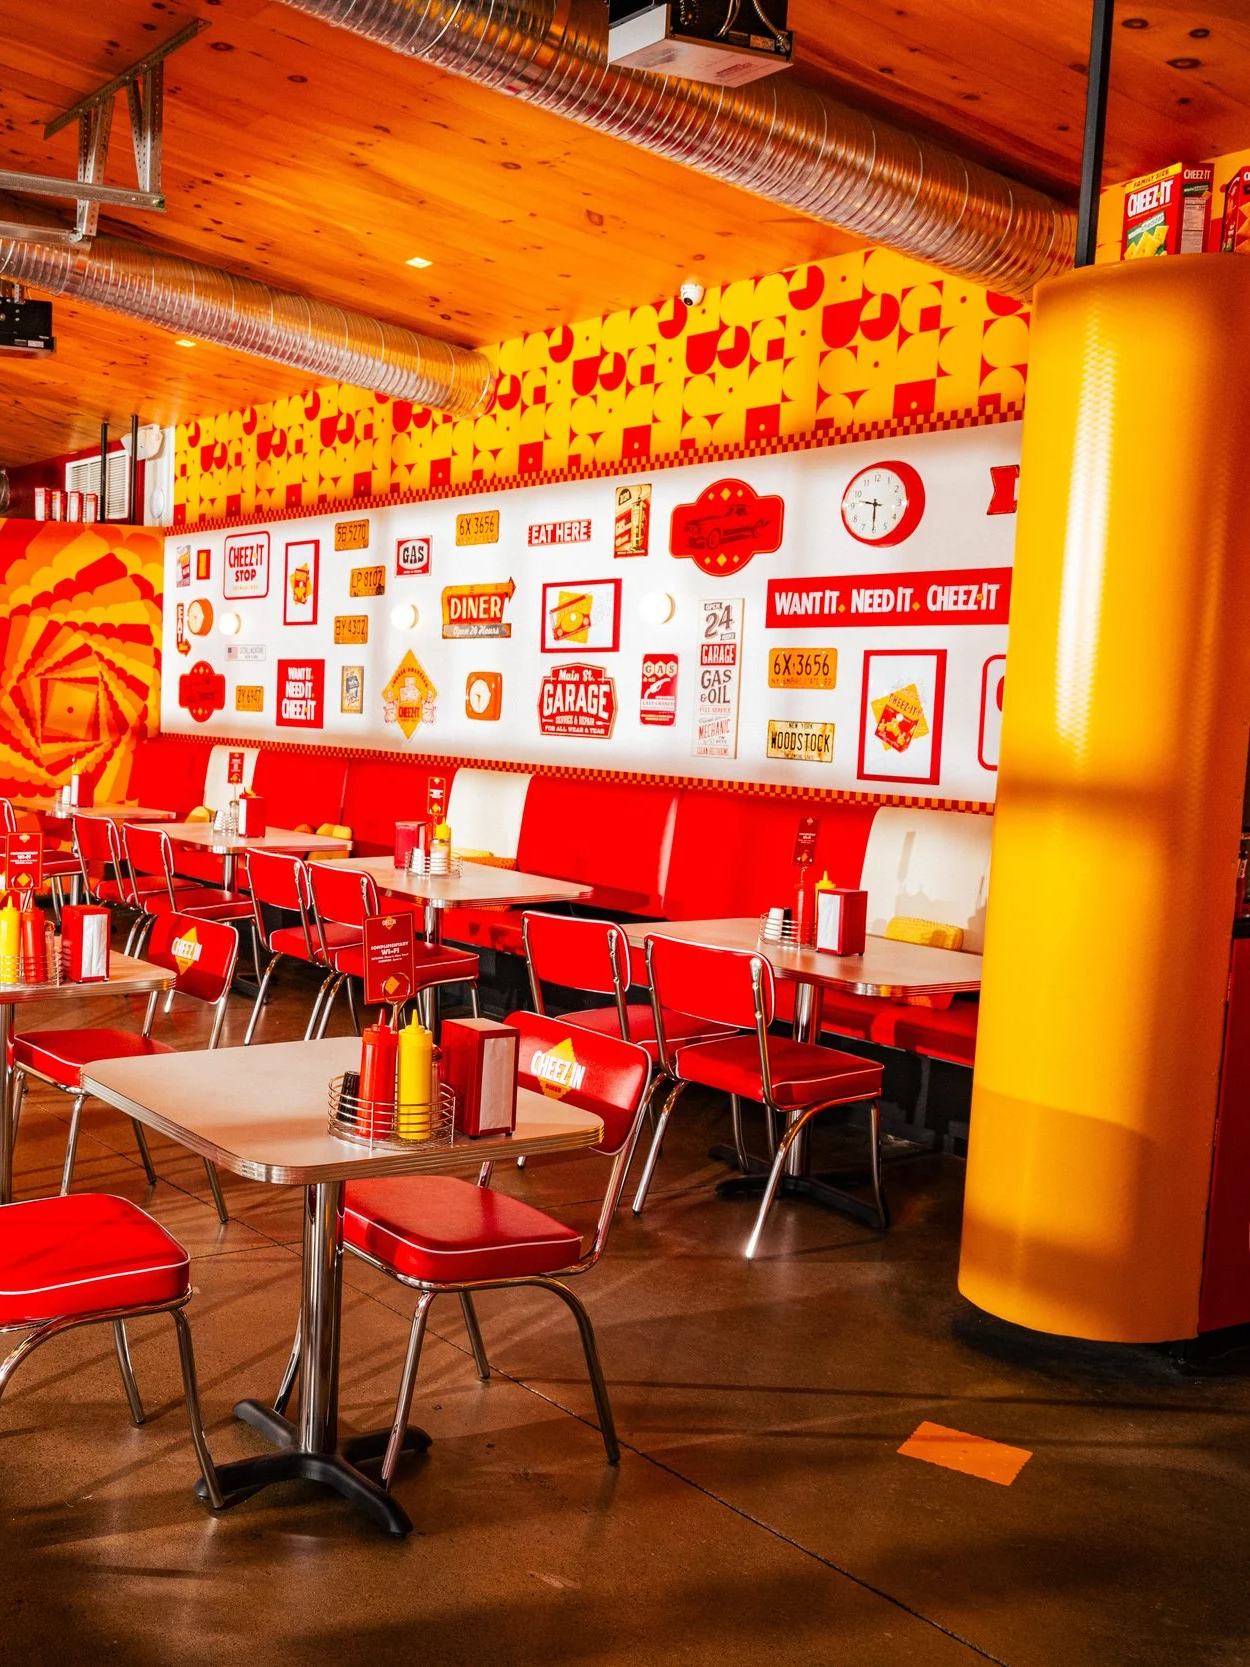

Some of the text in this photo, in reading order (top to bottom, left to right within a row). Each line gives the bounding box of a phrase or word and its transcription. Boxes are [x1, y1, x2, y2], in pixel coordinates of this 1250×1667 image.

[531, 521, 588, 545] EAT HERE
[402, 545, 424, 565] GAS
[235, 568, 257, 583] STOP
[451, 595, 502, 619] DINER
[774, 591, 823, 616] WANT
[851, 588, 895, 614] NEED
[704, 604, 733, 639] 24
[702, 645, 735, 664] GARAGE
[288, 667, 305, 680] WANT
[558, 669, 580, 681] Main
[645, 665, 675, 674] GAS
[701, 669, 732, 689] GAS
[285, 681, 305, 698] NEED
[707, 685, 731, 704] OIL
[543, 683, 610, 720] GARAGE
[771, 731, 831, 752] WOODSTOCK
[171, 936, 196, 961] CHEEZ
[370, 941, 409, 951] COMPLIMENTARY
[530, 1050, 587, 1091] CHEEZ IN
